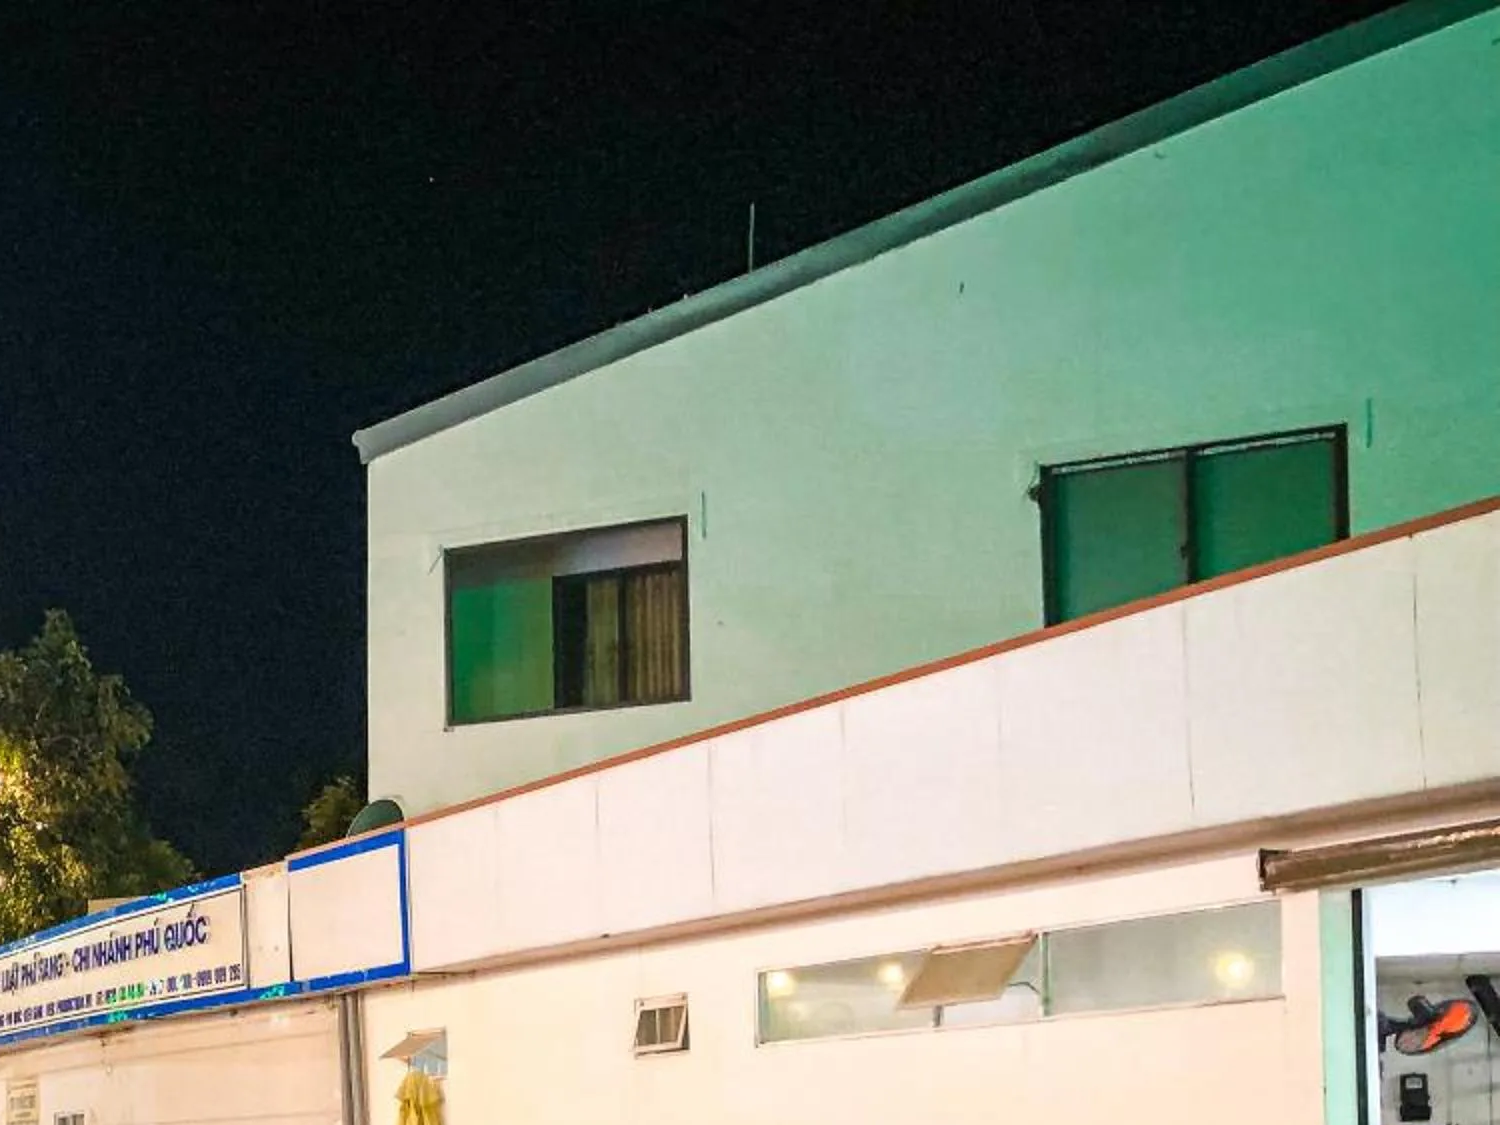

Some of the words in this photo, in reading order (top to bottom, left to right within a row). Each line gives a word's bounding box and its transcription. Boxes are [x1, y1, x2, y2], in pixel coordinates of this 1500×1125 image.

[72, 944, 90, 973] CHI
[92, 930, 132, 969] NHÁNH
[135, 917, 161, 960] PHÚ
[164, 902, 208, 951] QUỐC
